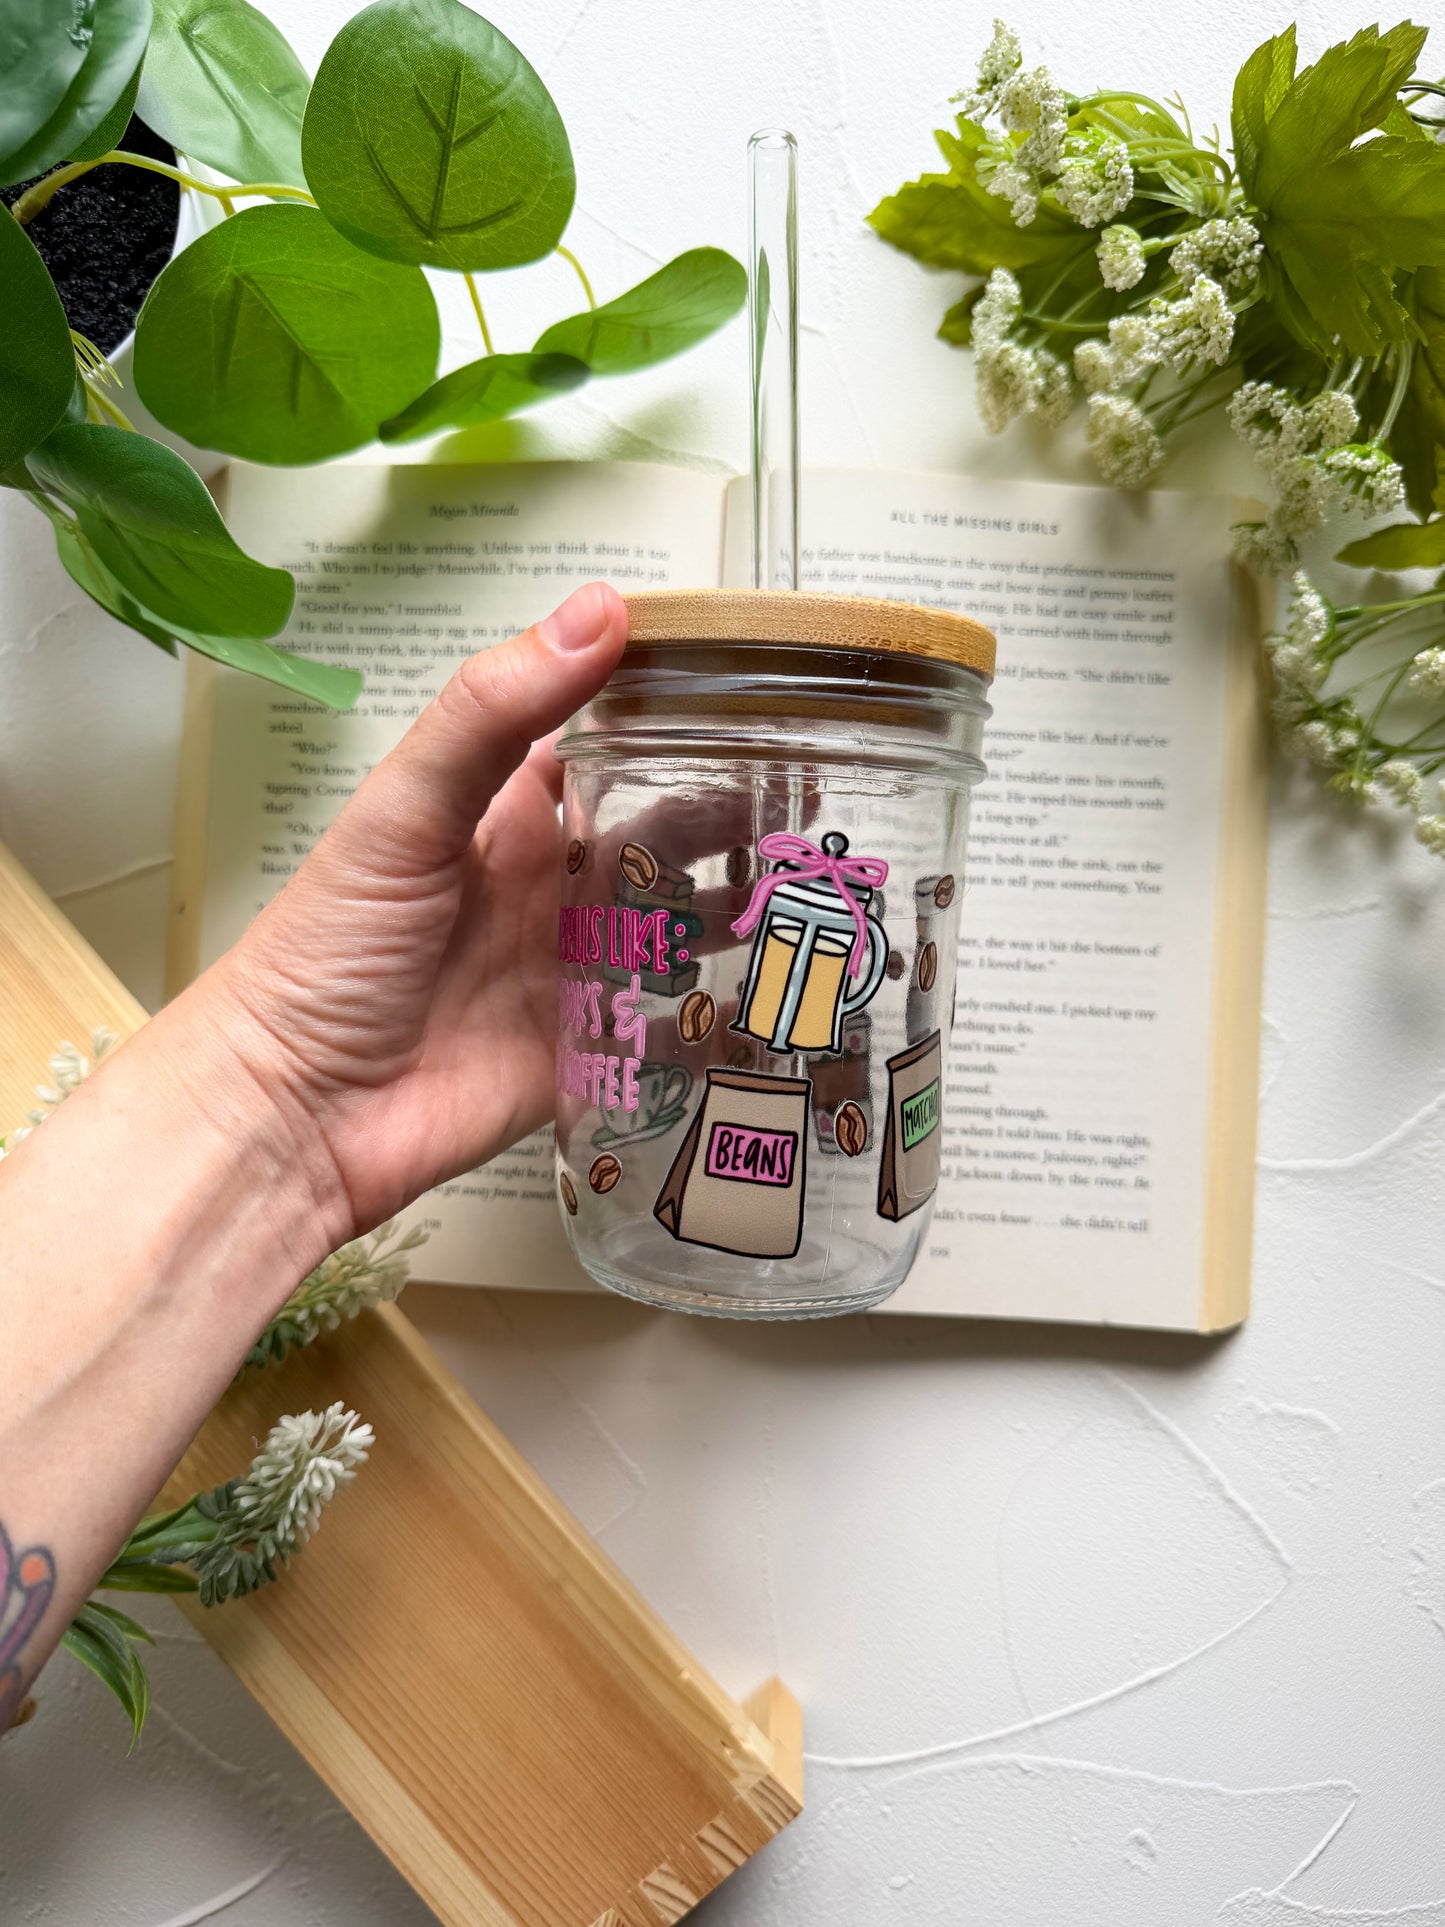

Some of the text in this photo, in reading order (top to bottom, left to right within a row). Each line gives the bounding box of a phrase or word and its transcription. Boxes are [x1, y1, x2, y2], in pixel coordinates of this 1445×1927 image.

[470, 503, 519, 517] Miranda
[891, 511, 1059, 536] ALL THE MISSING GIRLS
[398, 541, 418, 554] like
[484, 542, 523, 555] Unless
[528, 546, 551, 558] you
[557, 541, 588, 555] think
[595, 543, 629, 557] about
[322, 561, 350, 573] Who
[556, 562, 574, 576] the
[1016, 561, 1041, 574] that
[608, 907, 689, 975] LIKE:
[611, 974, 647, 1059] &
[714, 1129, 791, 1181] BEANS
